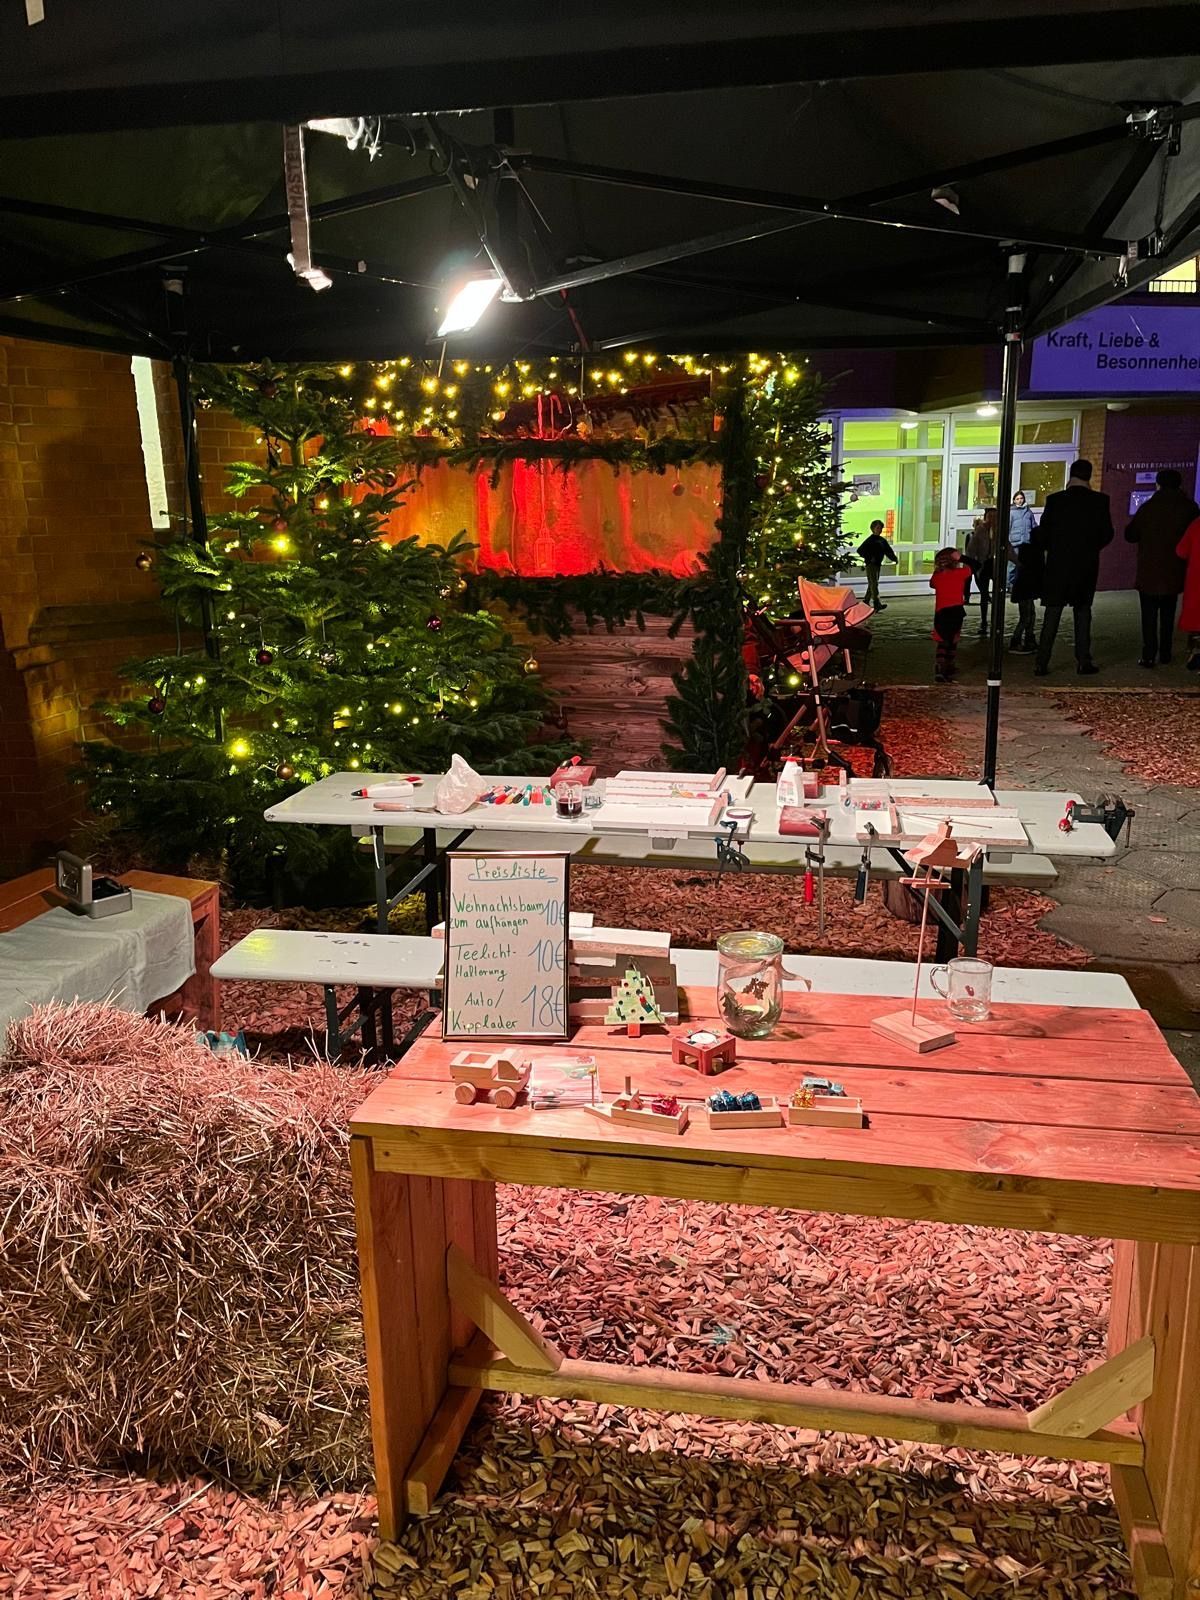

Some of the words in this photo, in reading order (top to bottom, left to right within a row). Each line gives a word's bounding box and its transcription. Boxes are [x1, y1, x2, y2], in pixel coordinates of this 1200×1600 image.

[1047, 331, 1092, 350] Kraft,
[1098, 331, 1144, 348] Liebe
[1149, 332, 1160, 348] &
[475, 858, 547, 880] Preisliste
[452, 892, 544, 914] Weihnachtsbaum
[540, 899, 565, 926] 10€
[450, 918, 468, 929] zum
[449, 943, 517, 961] Teelicht-
[528, 938, 565, 973] 10€
[455, 964, 508, 982] Halterung
[465, 989, 504, 1008] Auto/
[521, 985, 565, 1028] 18€
[452, 1010, 518, 1034] Kipplader
